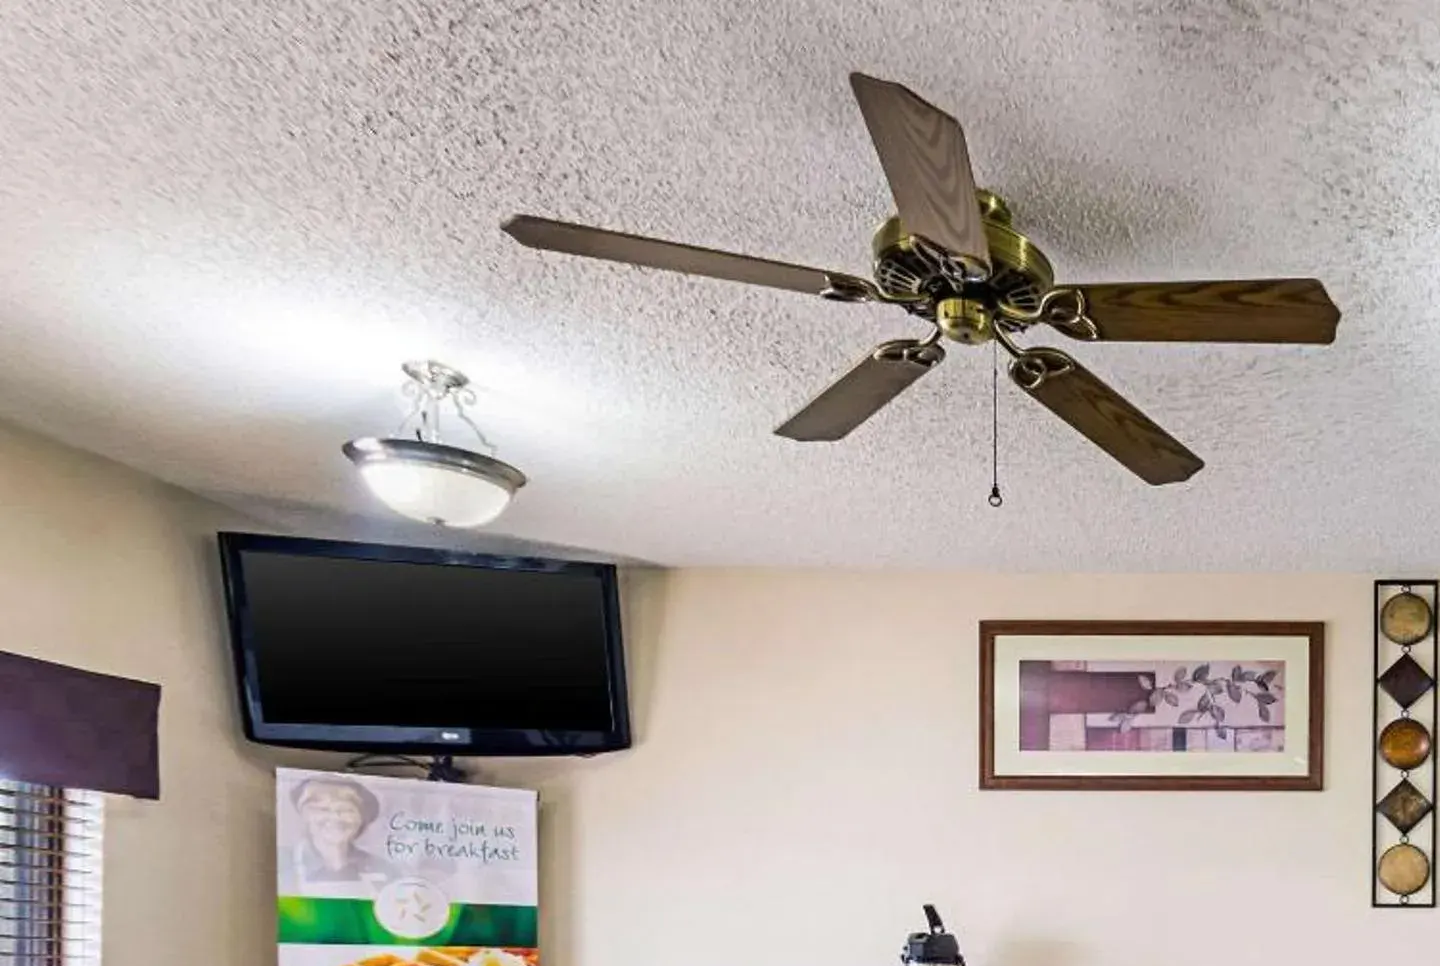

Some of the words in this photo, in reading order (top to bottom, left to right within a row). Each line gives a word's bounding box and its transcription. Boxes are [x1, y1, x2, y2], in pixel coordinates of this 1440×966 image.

[389, 811, 444, 834] Come
[450, 817, 487, 841] join
[494, 825, 516, 839] us
[386, 834, 418, 857] for
[424, 837, 520, 863] breakfast
